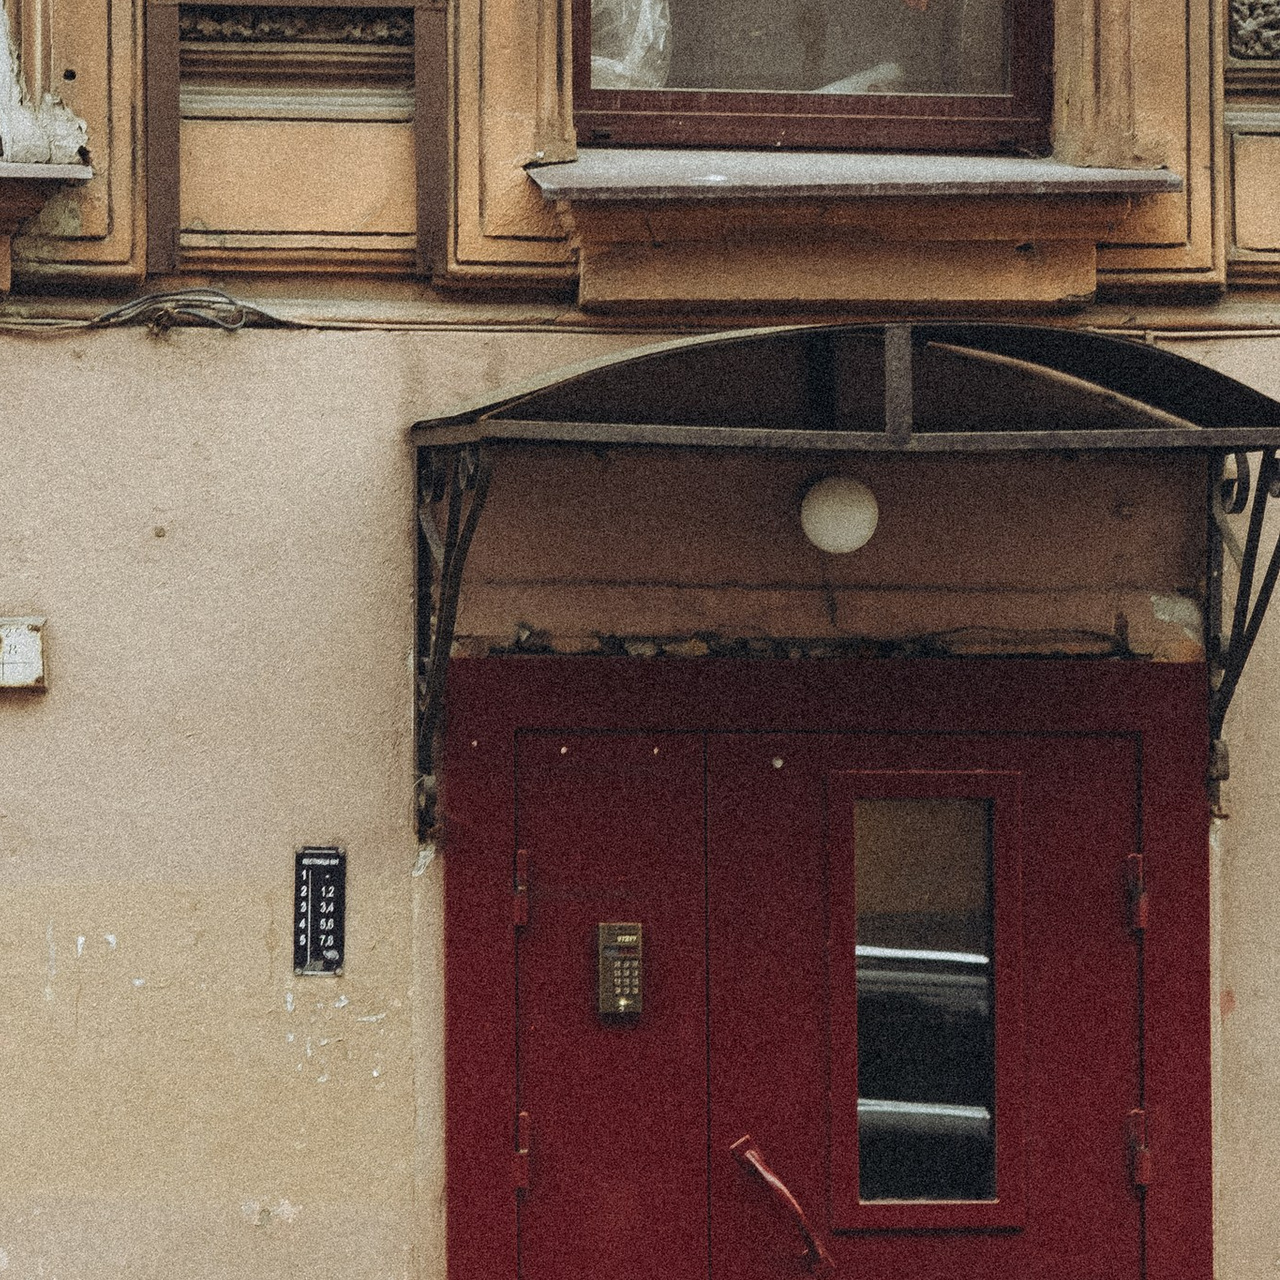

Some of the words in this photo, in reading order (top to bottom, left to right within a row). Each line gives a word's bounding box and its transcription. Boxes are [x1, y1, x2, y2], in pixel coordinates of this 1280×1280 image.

[302, 869, 307, 880] 1
[300, 885, 308, 897] 2
[321, 885, 335, 898] 1,2
[300, 901, 307, 913] 3
[320, 901, 335, 914] 3,4
[299, 917, 306, 930] 4
[299, 934, 306, 946] 5
